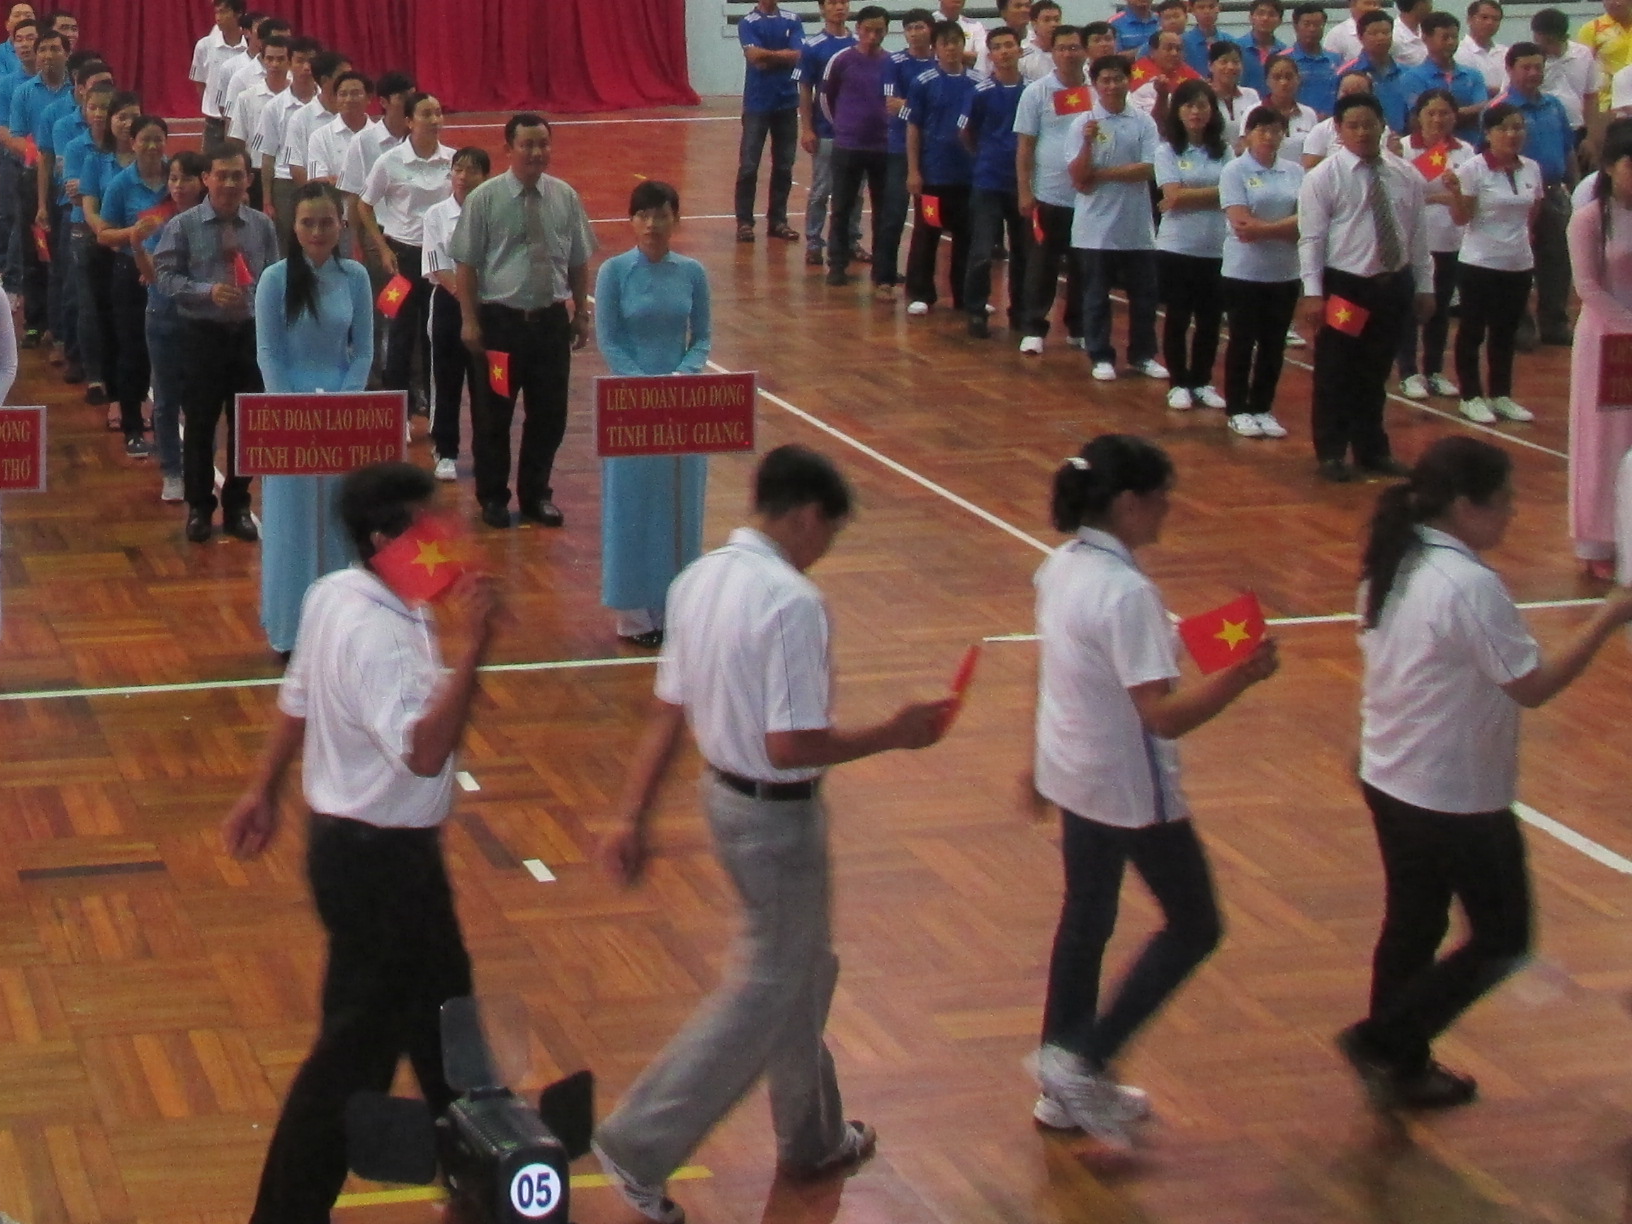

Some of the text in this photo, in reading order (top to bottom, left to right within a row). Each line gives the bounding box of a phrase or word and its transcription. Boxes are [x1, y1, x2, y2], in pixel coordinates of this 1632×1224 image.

[681, 386, 706, 408] LAO
[326, 409, 352, 430] LAO
[693, 422, 744, 444] GIANG
[295, 435, 342, 467] ĐỒNG
[1, 455, 31, 481] THƠ
[517, 1172, 552, 1209] 05
